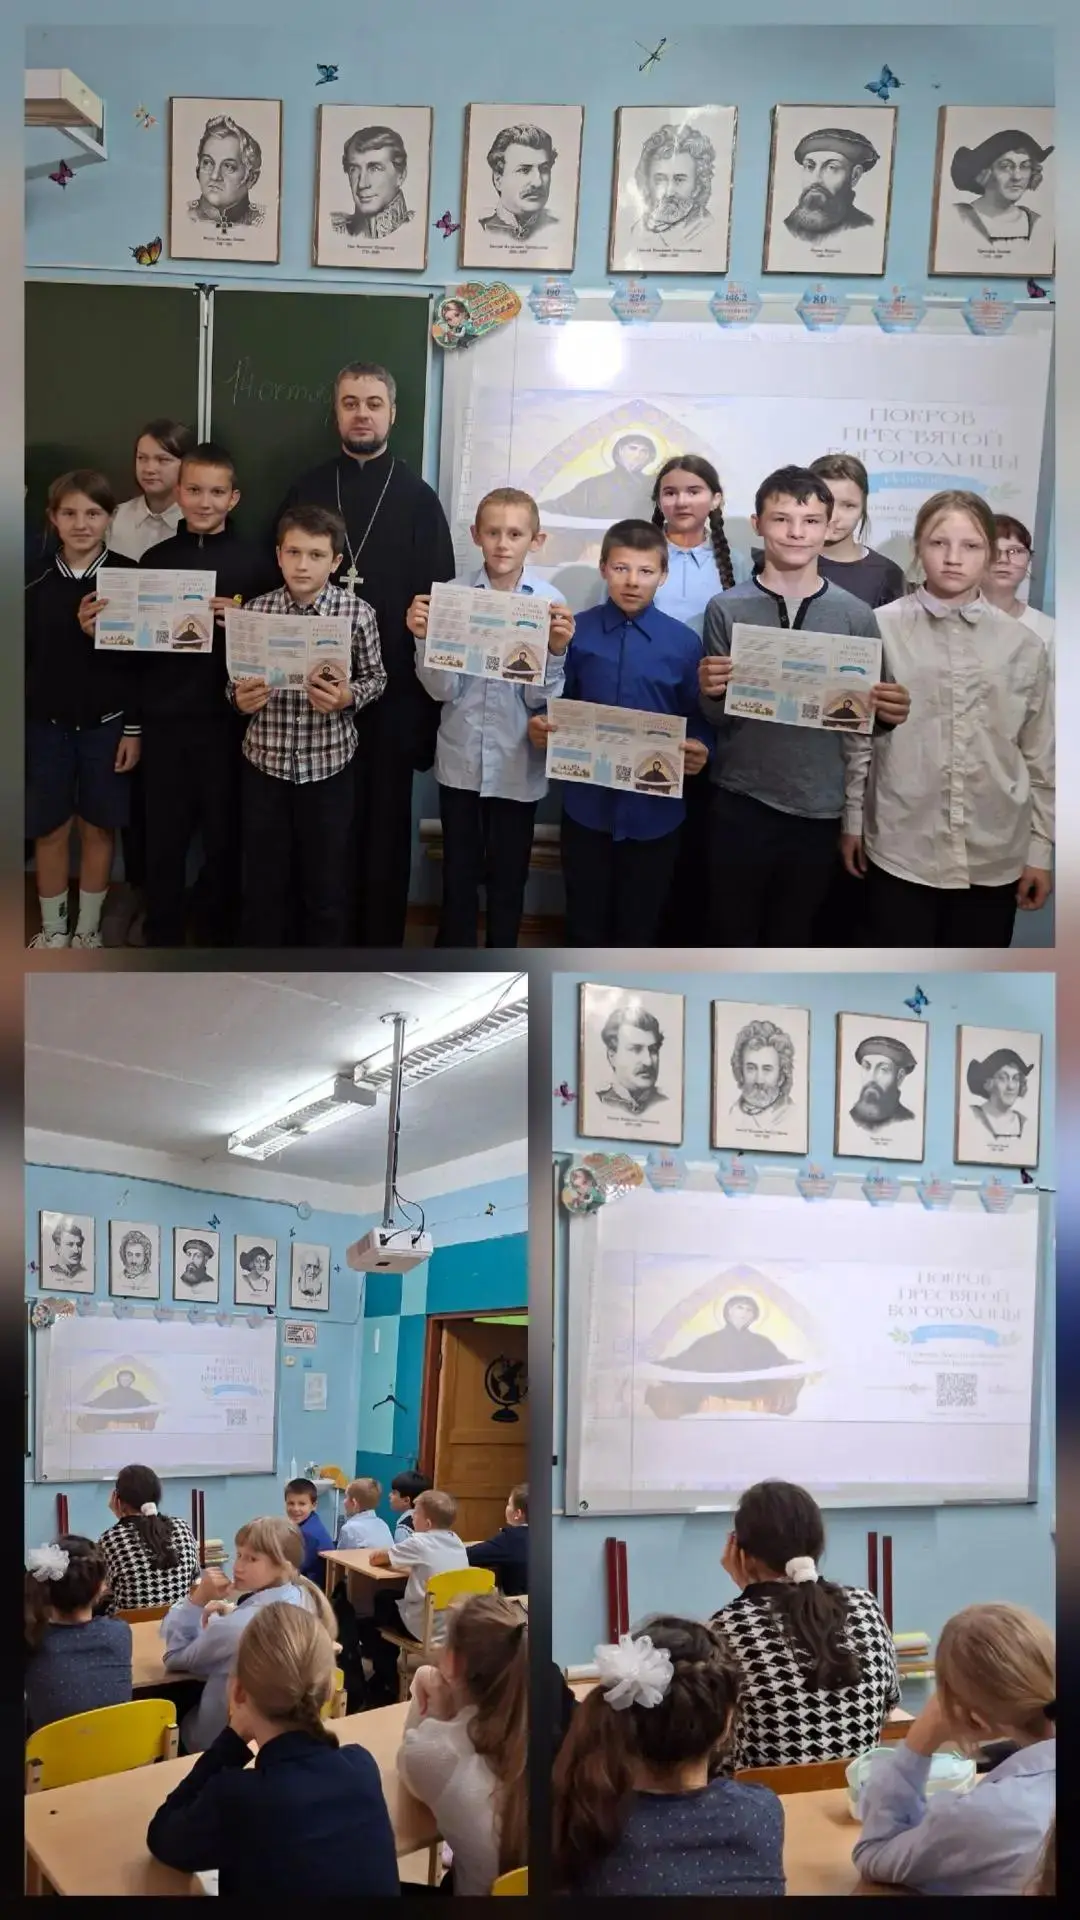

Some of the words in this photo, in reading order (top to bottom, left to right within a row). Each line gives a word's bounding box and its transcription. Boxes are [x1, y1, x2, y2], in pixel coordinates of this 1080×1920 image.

[869, 407, 976, 426] ПОКРОВ
[841, 425, 1004, 448] ПРЕСВЯТОЙ
[916, 1270, 992, 1286] ПОКРОВ
[897, 1287, 1010, 1304] ПРЕСВЯТОЙ
[887, 1304, 1021, 1322] БОГОРОДИЦЫ
